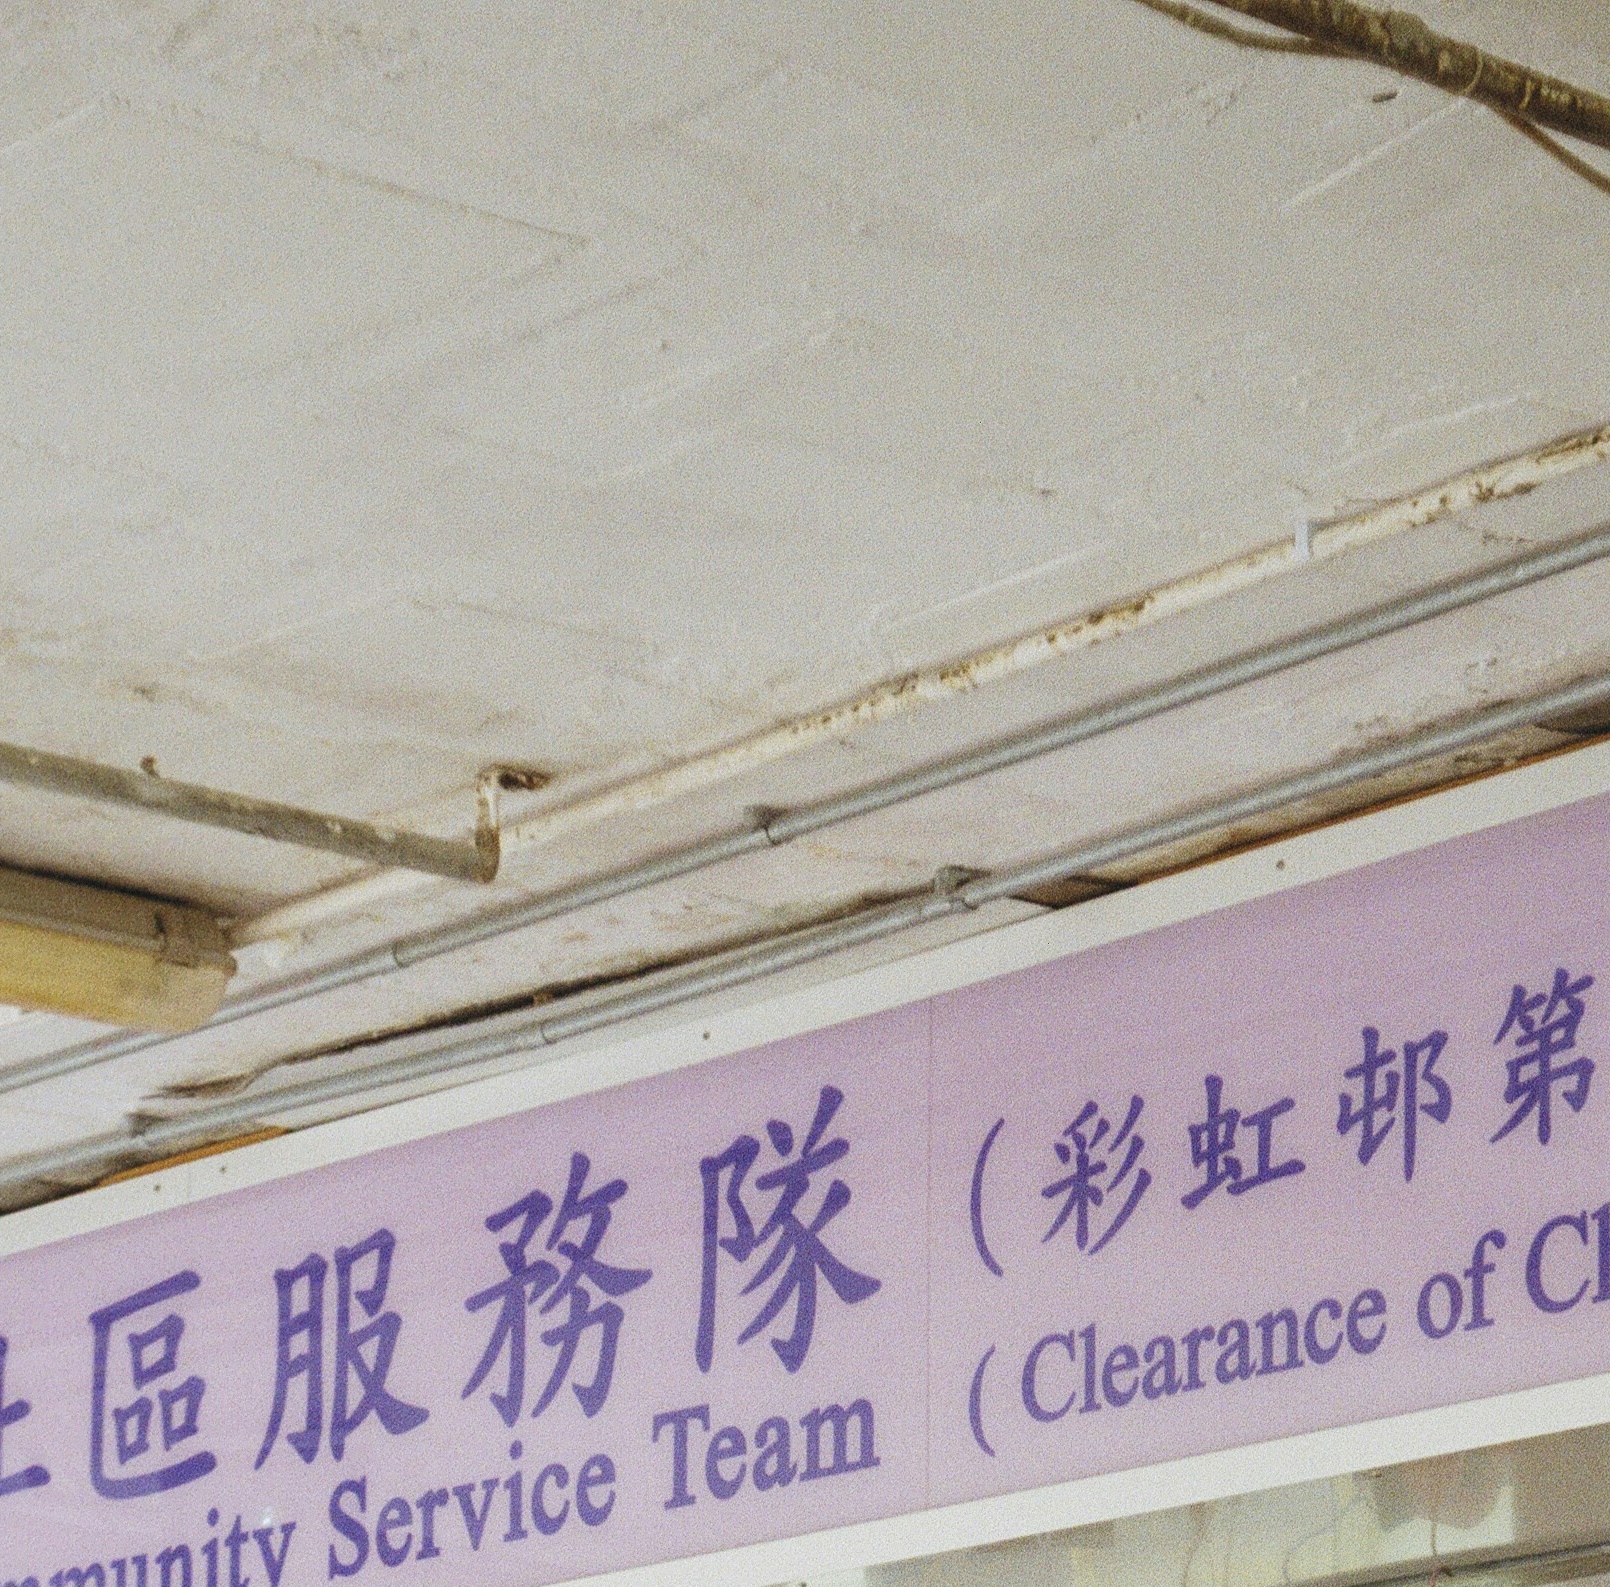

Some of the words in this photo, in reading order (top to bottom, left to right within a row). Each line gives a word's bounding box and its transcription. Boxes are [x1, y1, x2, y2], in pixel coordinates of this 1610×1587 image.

[1414, 1230, 1508, 1343] of
[326, 1440, 617, 1580] Service
[651, 1396, 880, 1512] Team
